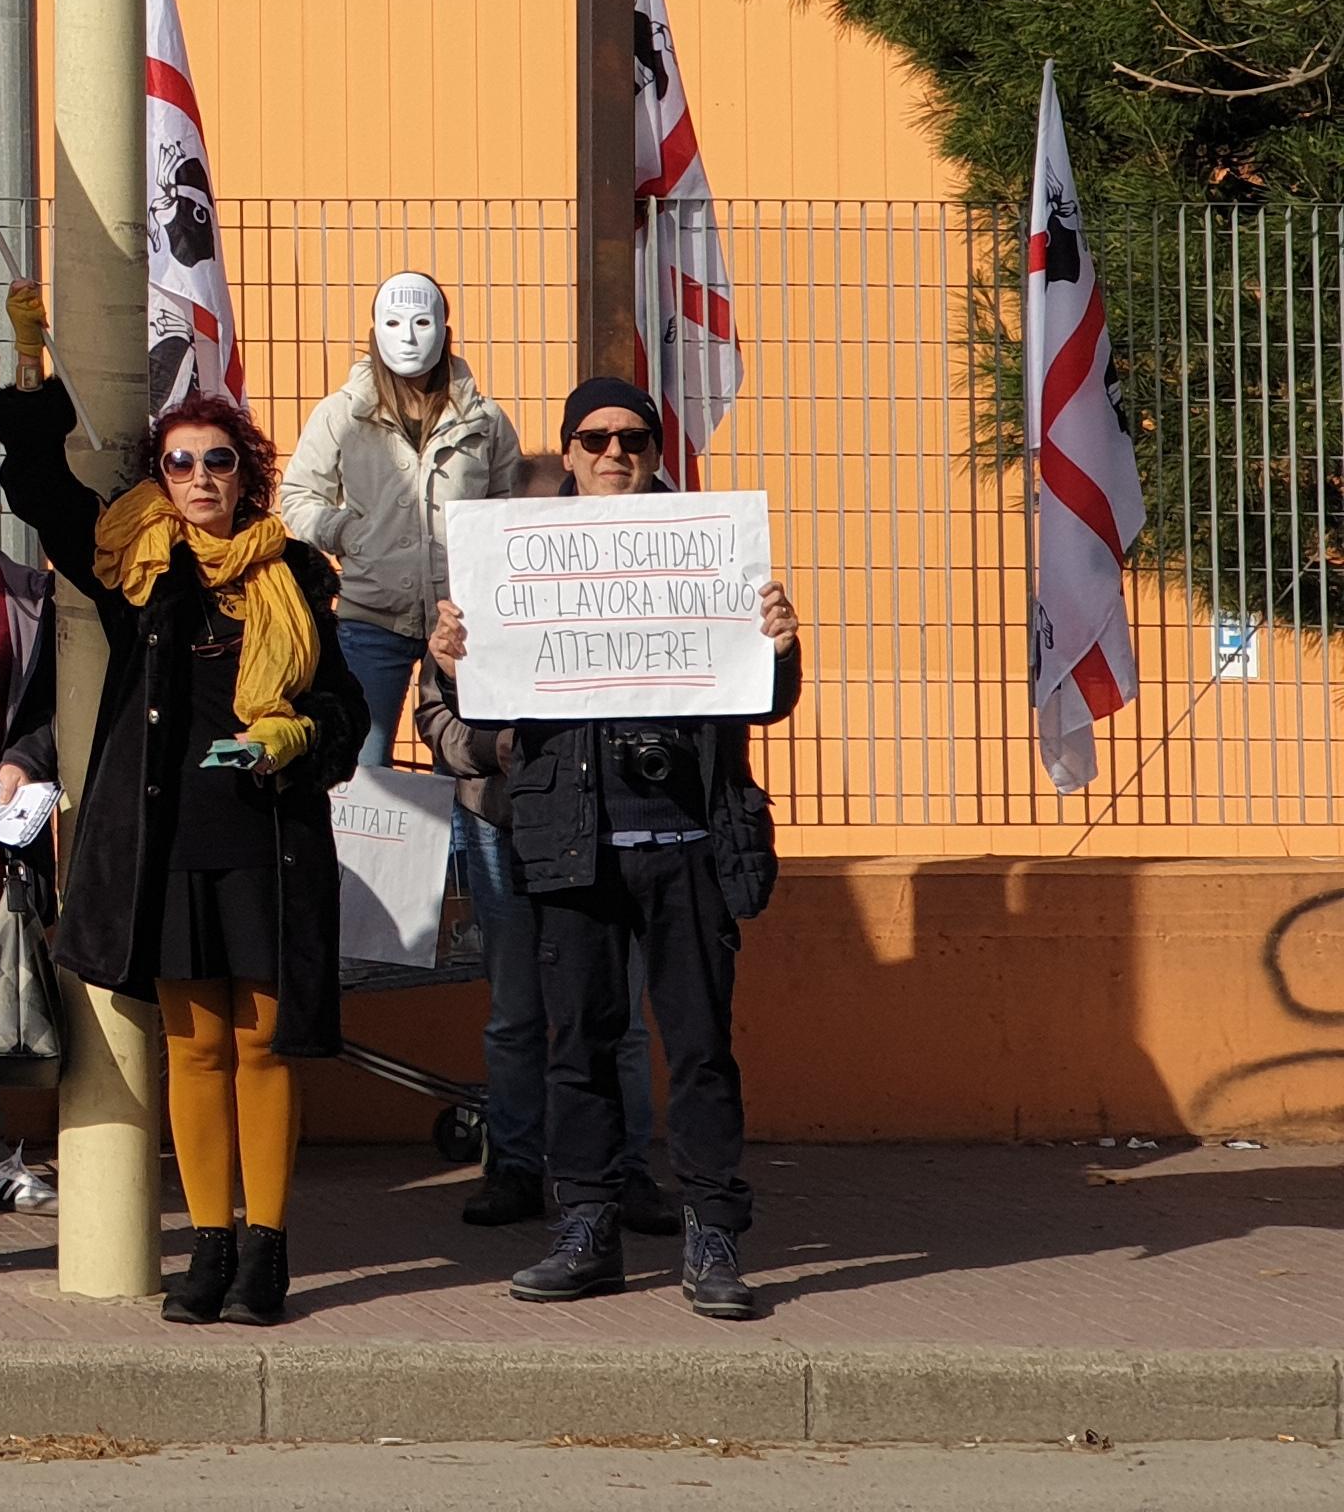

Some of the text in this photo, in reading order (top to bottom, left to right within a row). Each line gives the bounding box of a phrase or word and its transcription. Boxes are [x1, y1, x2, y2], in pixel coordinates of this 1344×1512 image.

[507, 532, 599, 572] CONAD
[495, 584, 537, 618] CHI
[557, 580, 655, 619] LAVORA
[667, 579, 708, 618] NON
[535, 627, 714, 675] ATTENDERE!
